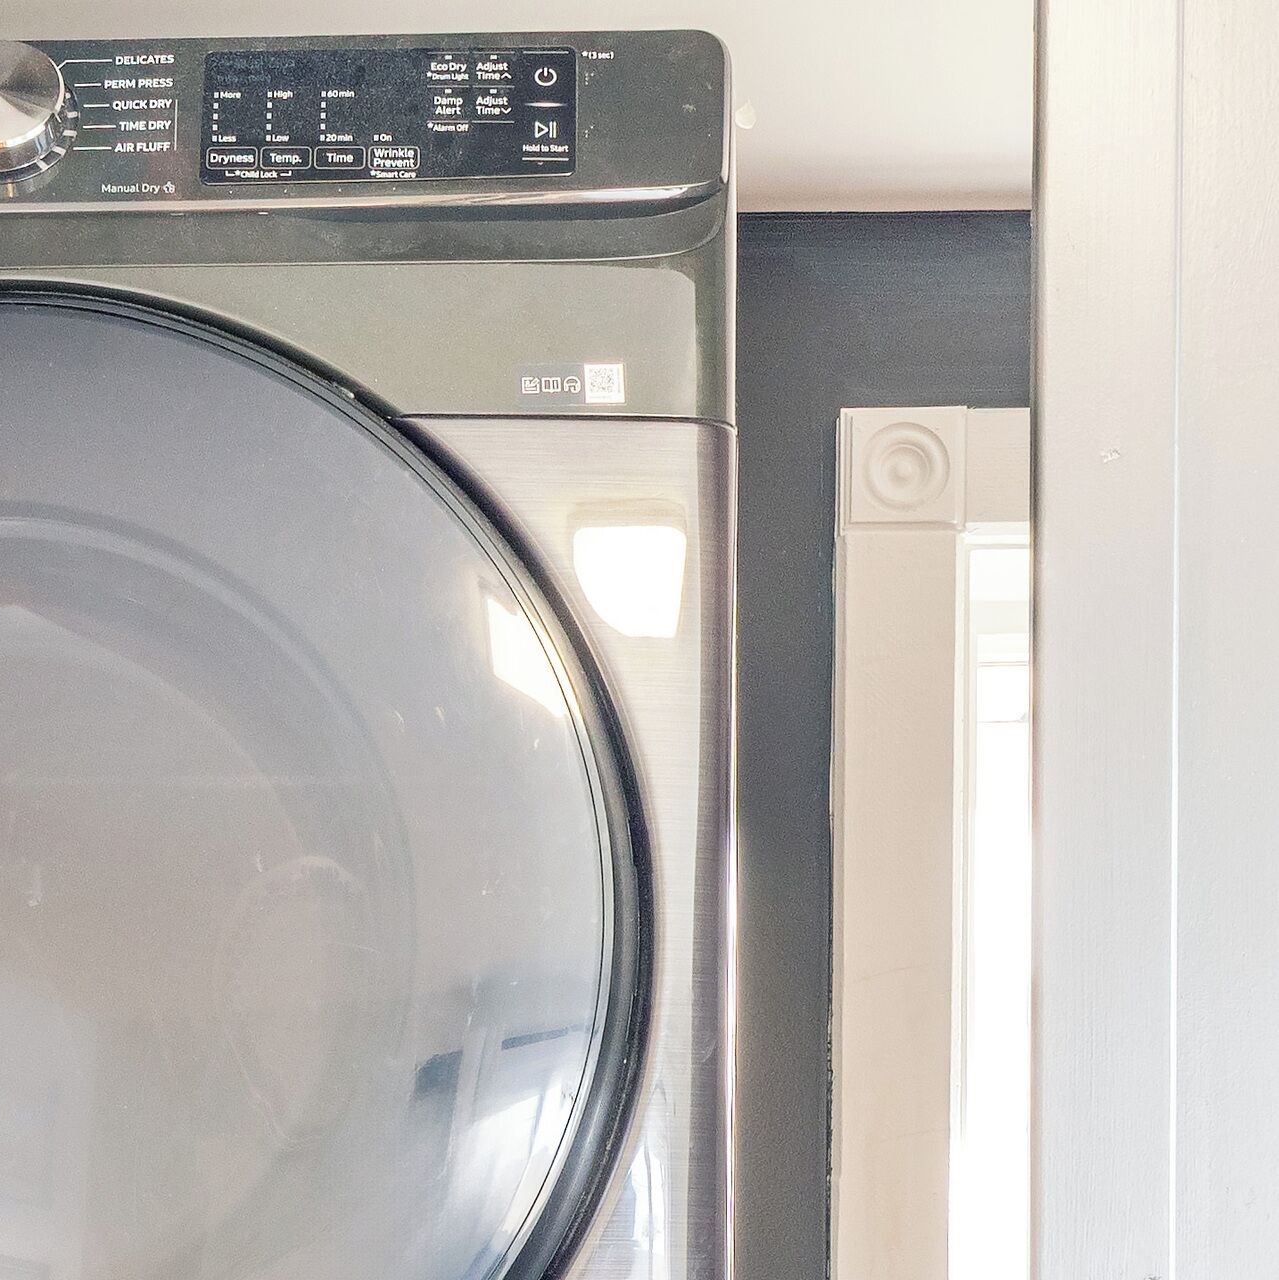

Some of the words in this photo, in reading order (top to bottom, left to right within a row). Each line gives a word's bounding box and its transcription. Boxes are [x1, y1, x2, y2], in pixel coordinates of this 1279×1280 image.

[115, 55, 174, 65] DELICATES
[431, 62, 448, 71] Eco
[448, 62, 467, 73] Dry
[476, 62, 508, 73] Adjust
[476, 72, 500, 80] Time
[104, 79, 136, 89] PERM
[138, 78, 173, 88] PRESS
[220, 91, 241, 99] More
[273, 91, 293, 99] High
[327, 90, 338, 98] 60
[339, 90, 355, 98] min
[112, 101, 147, 111] QUICK
[149, 99, 173, 109] DRY
[434, 96, 463, 106] Damp
[476, 96, 508, 106] Adjust
[435, 106, 461, 115] Alert
[476, 106, 500, 115] Time
[119, 121, 147, 131] TIME
[148, 120, 172, 130] DRY
[456, 124, 469, 132] Off
[218, 134, 237, 142] Less
[272, 134, 290, 142] Low
[325, 134, 338, 142] 20
[338, 134, 353, 142] min
[380, 134, 392, 142] On
[114, 143, 135, 153] AIR
[136, 142, 170, 152] FLUFF
[523, 144, 540, 152] Hold
[550, 144, 568, 152] Start
[326, 153, 354, 163] Time
[373, 148, 415, 158] Wrinkle
[210, 153, 255, 165] Dryness
[269, 153, 302, 164] Temp.
[373, 158, 415, 168] Prevent
[101, 183, 139, 193] Manual
[141, 184, 160, 195] Dry
